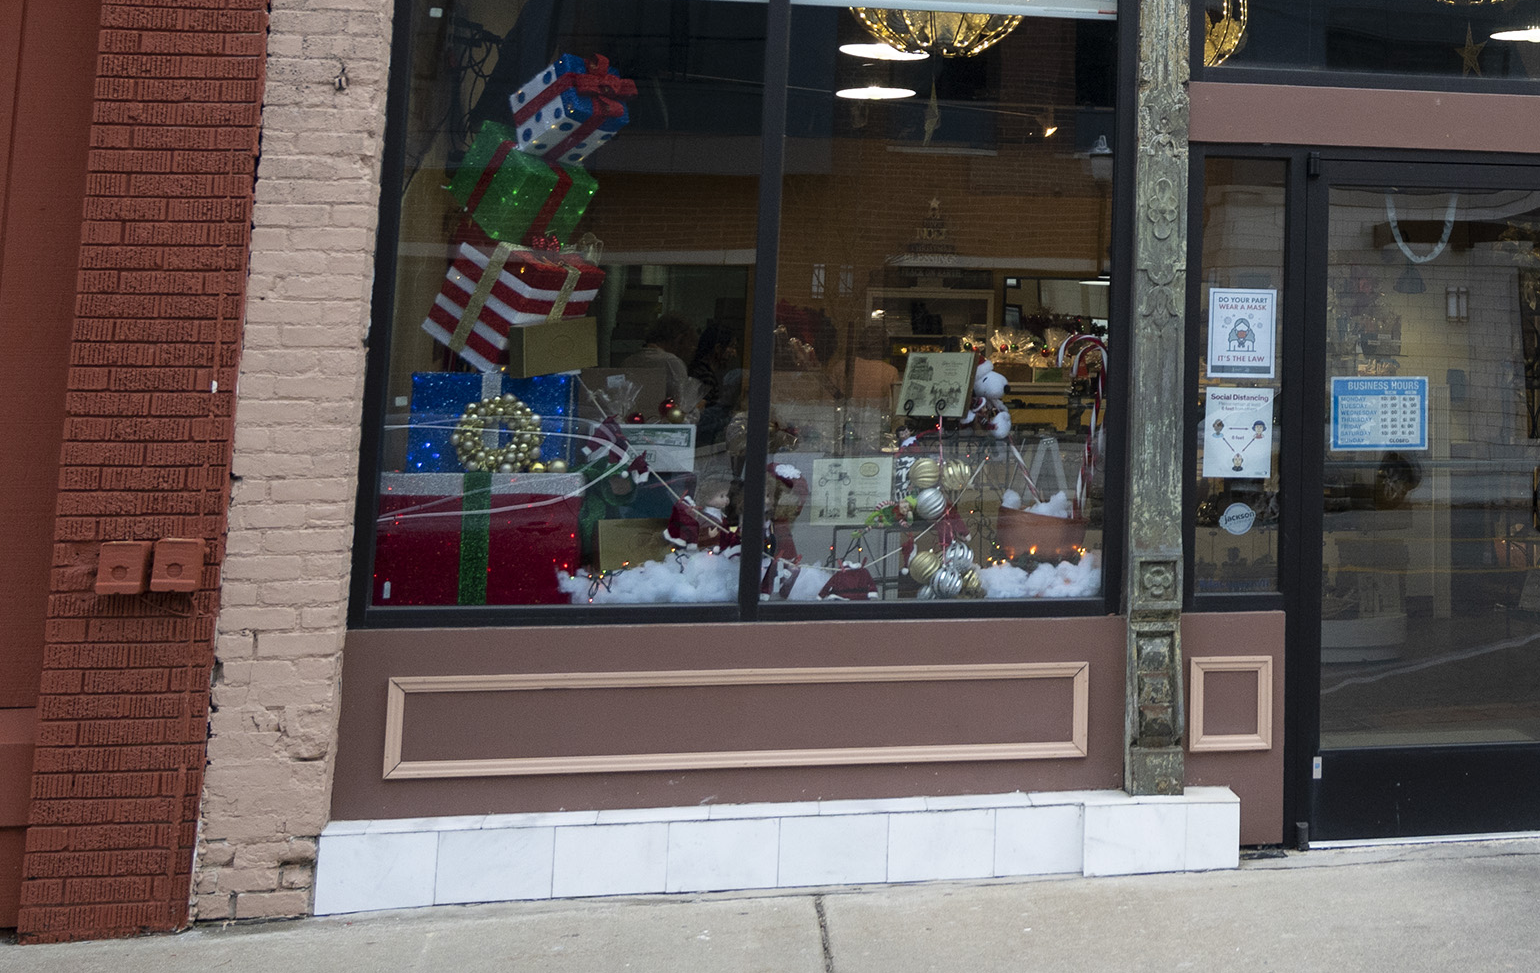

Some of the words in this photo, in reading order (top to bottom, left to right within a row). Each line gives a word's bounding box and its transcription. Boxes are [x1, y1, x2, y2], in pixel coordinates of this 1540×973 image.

[1348, 381, 1389, 390] BUSINESS
[1391, 381, 1419, 390] HOURS
[1211, 393, 1232, 401] Social
[1232, 394, 1269, 403] Distancing
